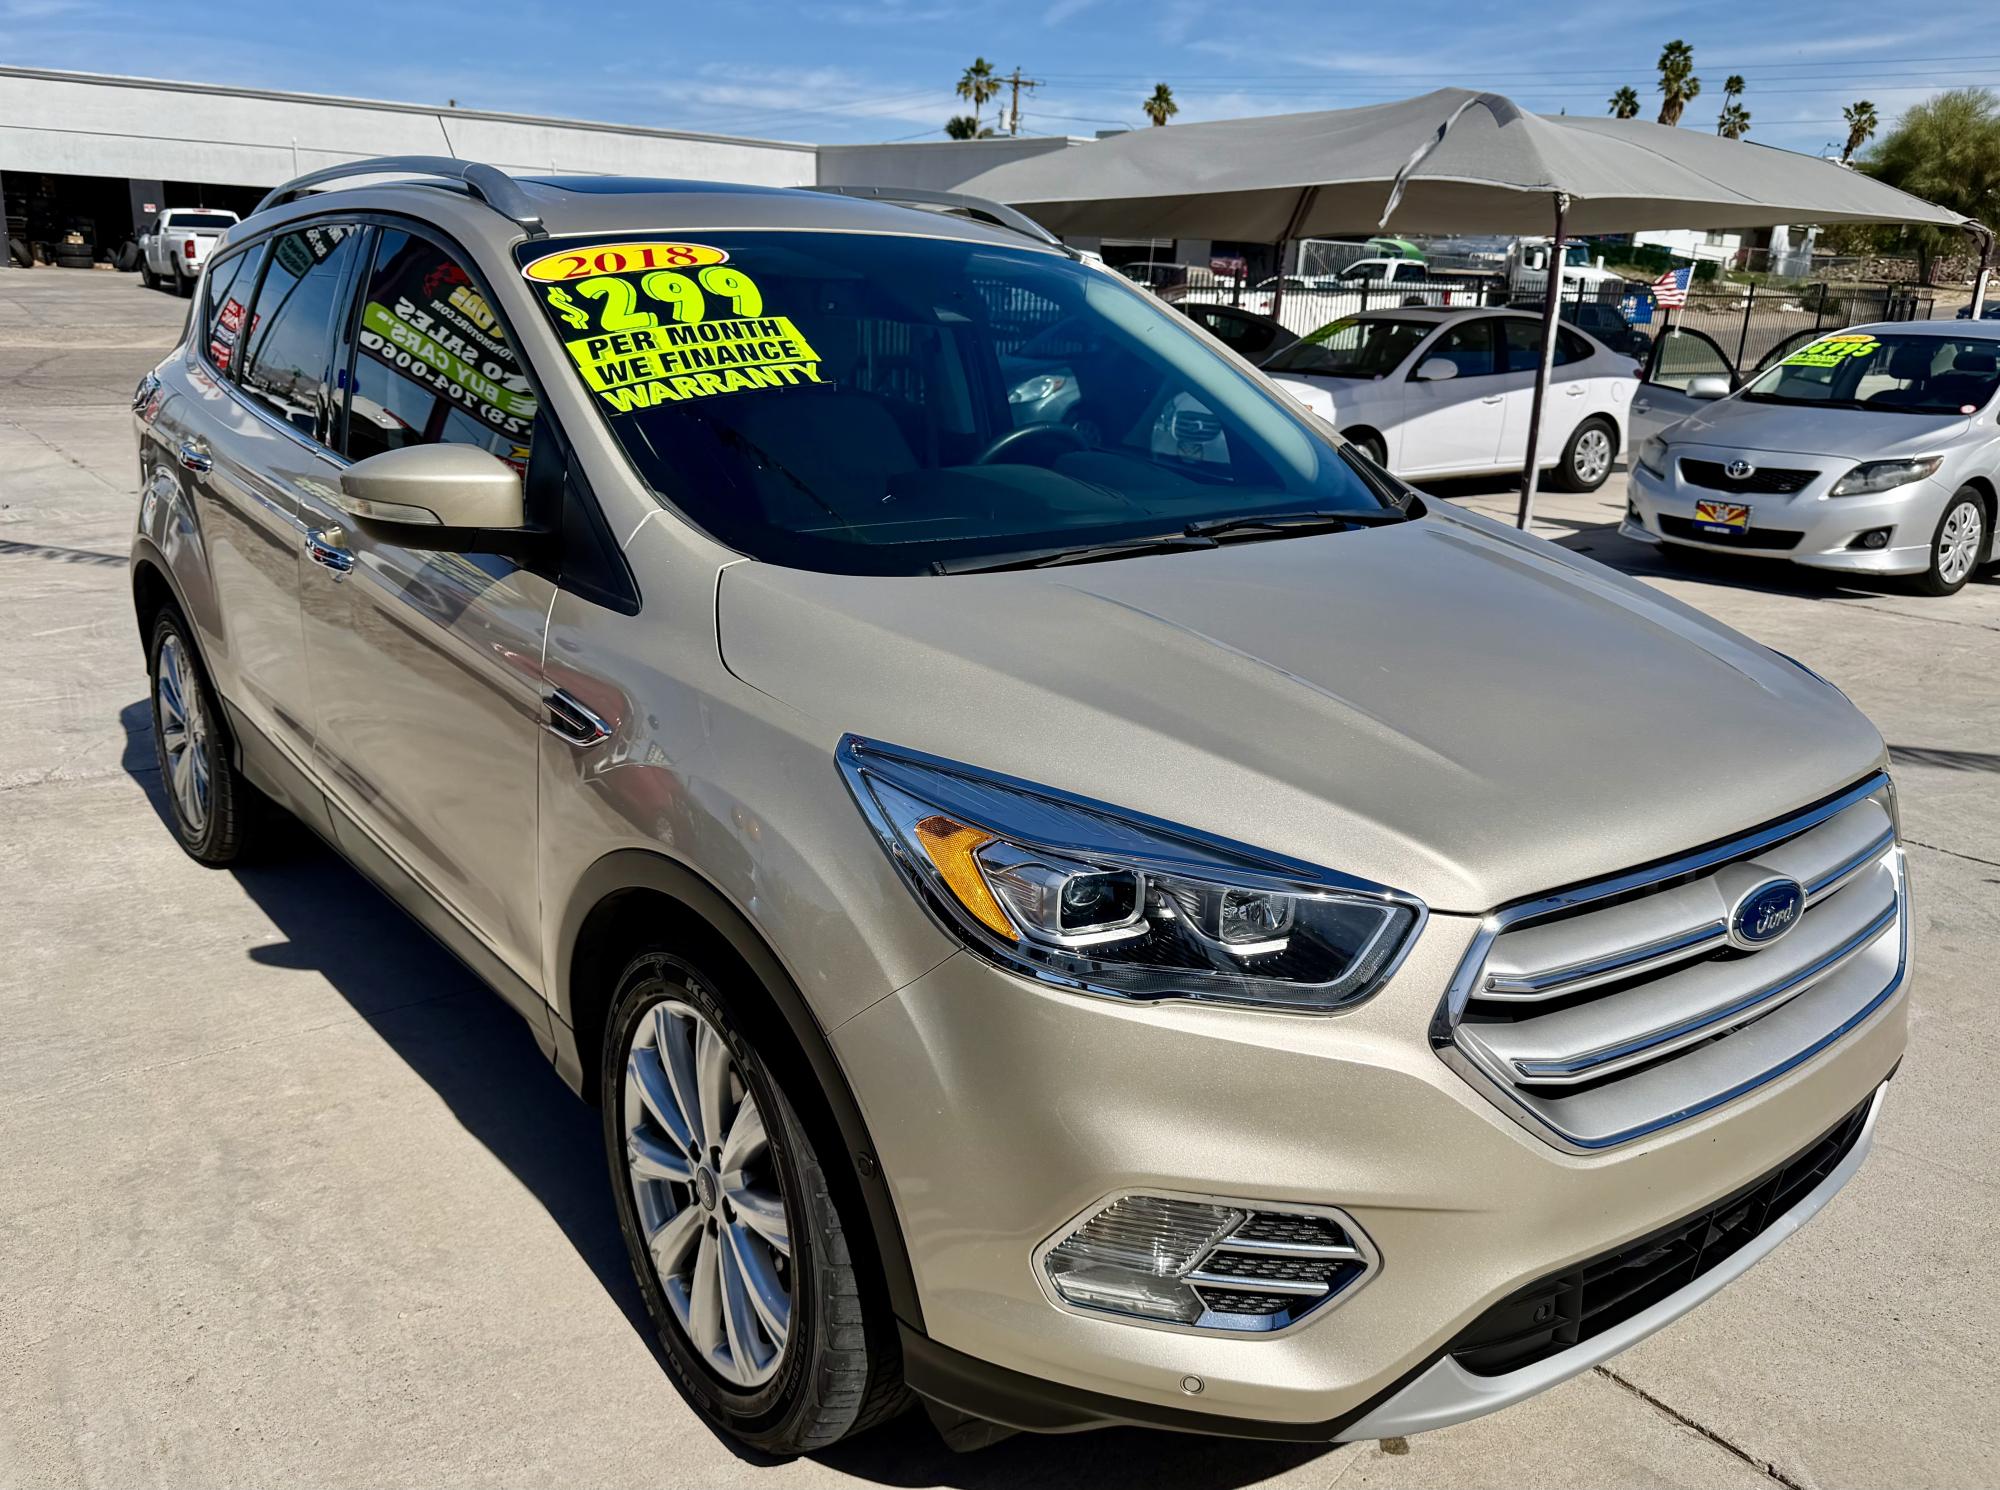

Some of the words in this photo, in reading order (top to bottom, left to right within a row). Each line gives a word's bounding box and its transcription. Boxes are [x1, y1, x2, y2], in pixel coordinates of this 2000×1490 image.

[558, 246, 698, 279] 2018
[547, 266, 763, 332] $299
[586, 331, 654, 361] PER
[669, 319, 784, 348] MONTH
[595, 356, 653, 386] WE
[659, 340, 801, 373] FINANCE
[600, 361, 822, 413] WARRANTY
[1756, 894, 1796, 934] Ford
